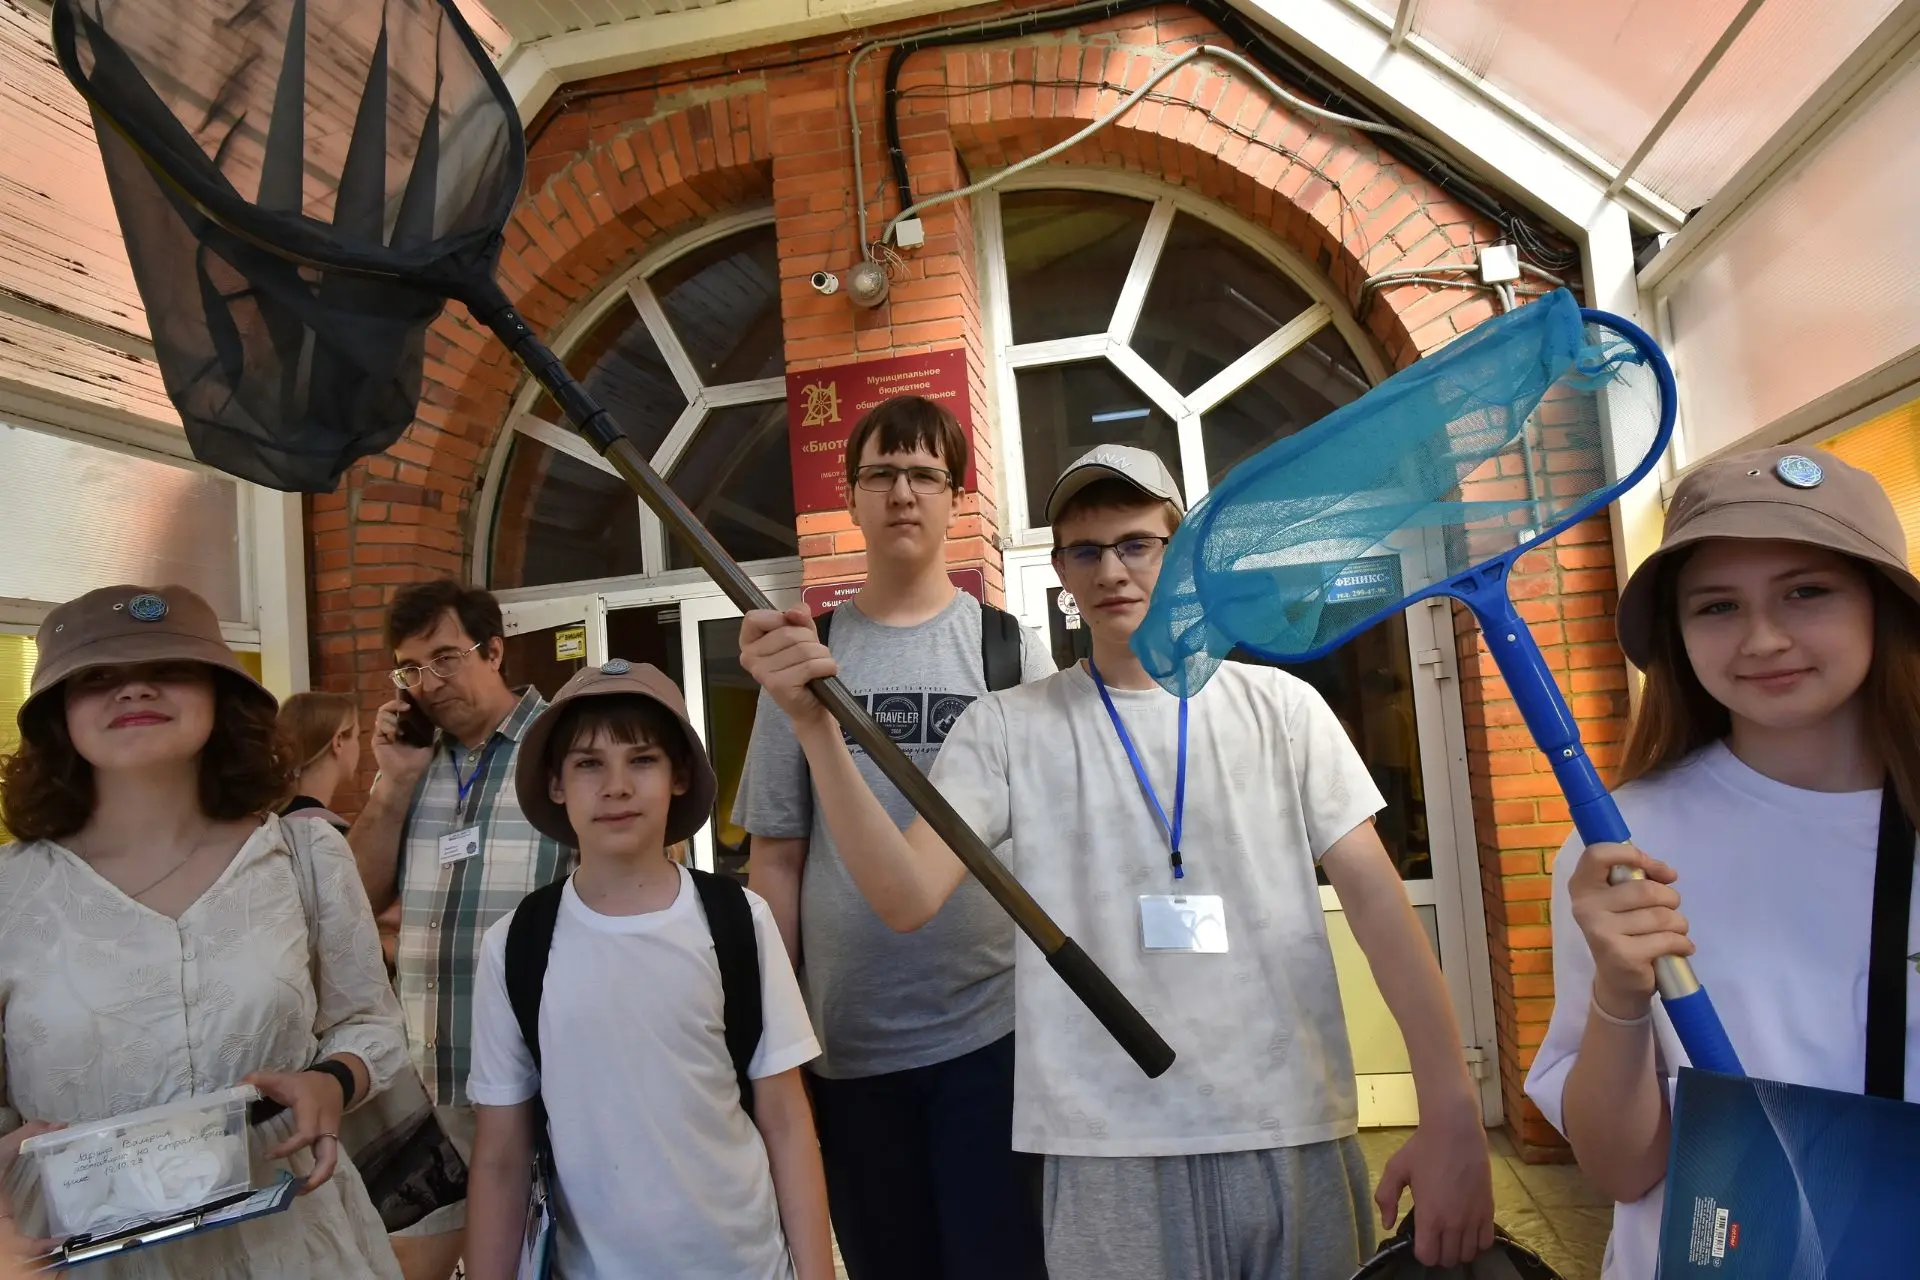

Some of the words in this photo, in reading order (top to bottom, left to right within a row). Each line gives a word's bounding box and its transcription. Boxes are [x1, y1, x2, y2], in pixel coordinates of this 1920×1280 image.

[866, 368, 941, 385] Муниципальное
[878, 381, 931, 395] бюджетное
[874, 711, 919, 724] TRAVELER
